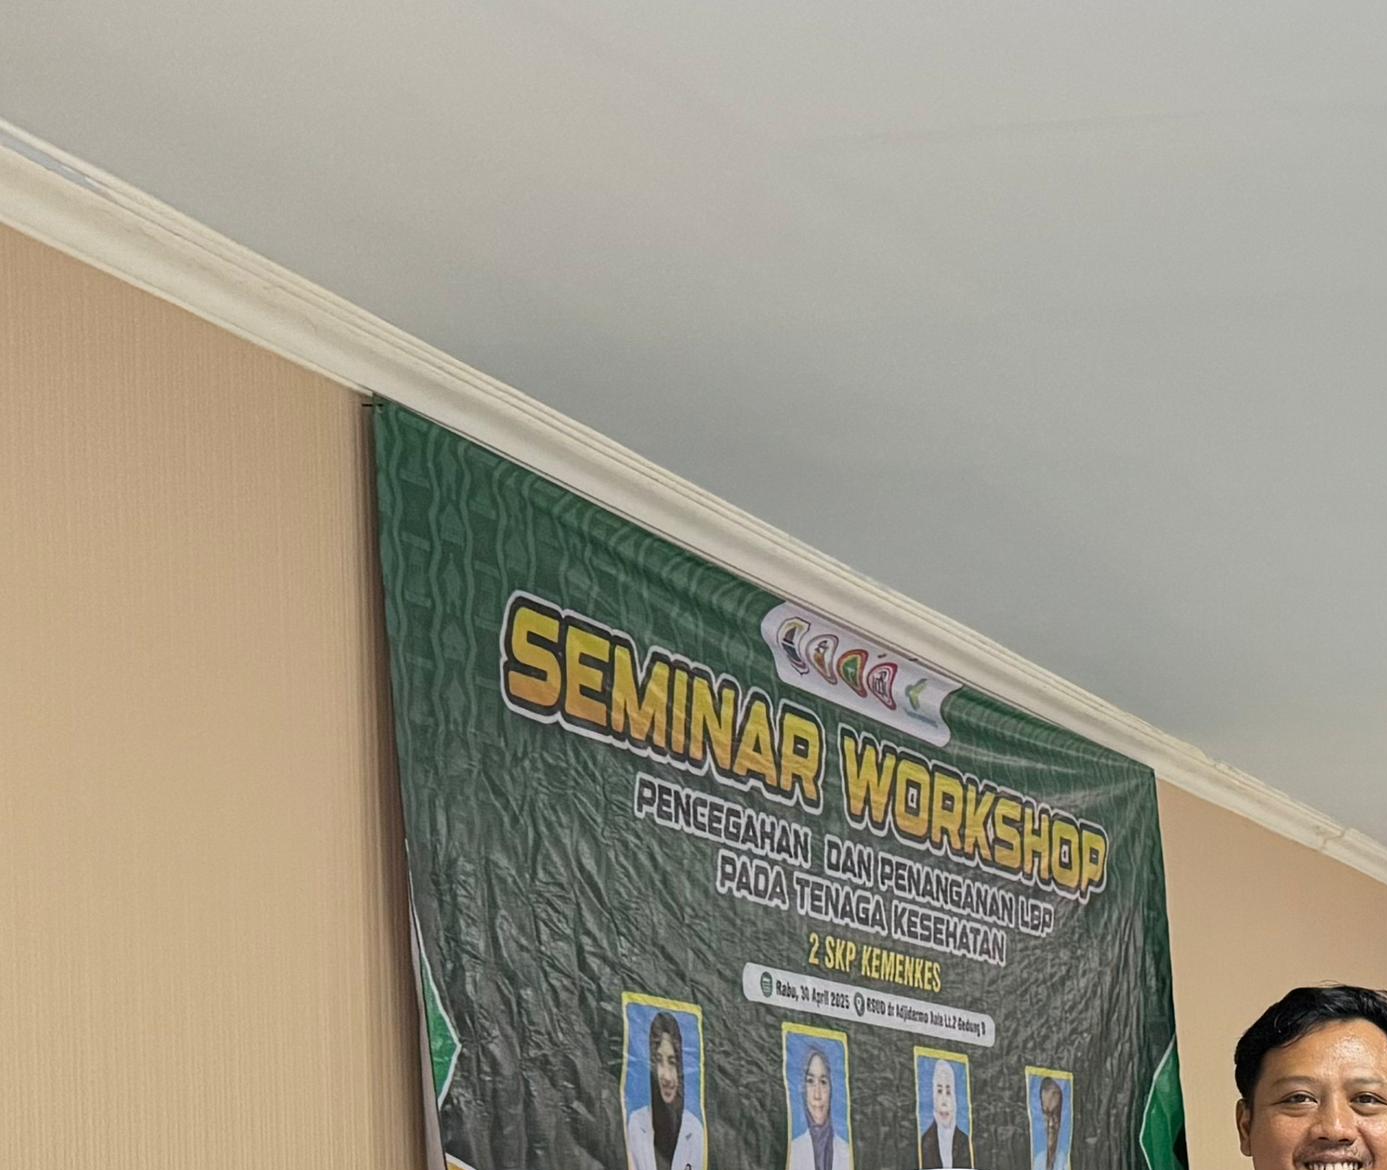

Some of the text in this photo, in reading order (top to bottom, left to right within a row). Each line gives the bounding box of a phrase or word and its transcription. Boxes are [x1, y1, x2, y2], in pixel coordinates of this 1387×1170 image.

[503, 595, 1108, 897] SEMINAR WORKSHOP
[635, 774, 1054, 937] PENCEGAHAN DAN PENANGANAN LBP
[719, 851, 1006, 967] PADA TENAGA KESEHATAN
[808, 932, 942, 993] 2 SKP KEMENKES
[812, 988, 829, 1007] April
[830, 992, 850, 1009] 2025
